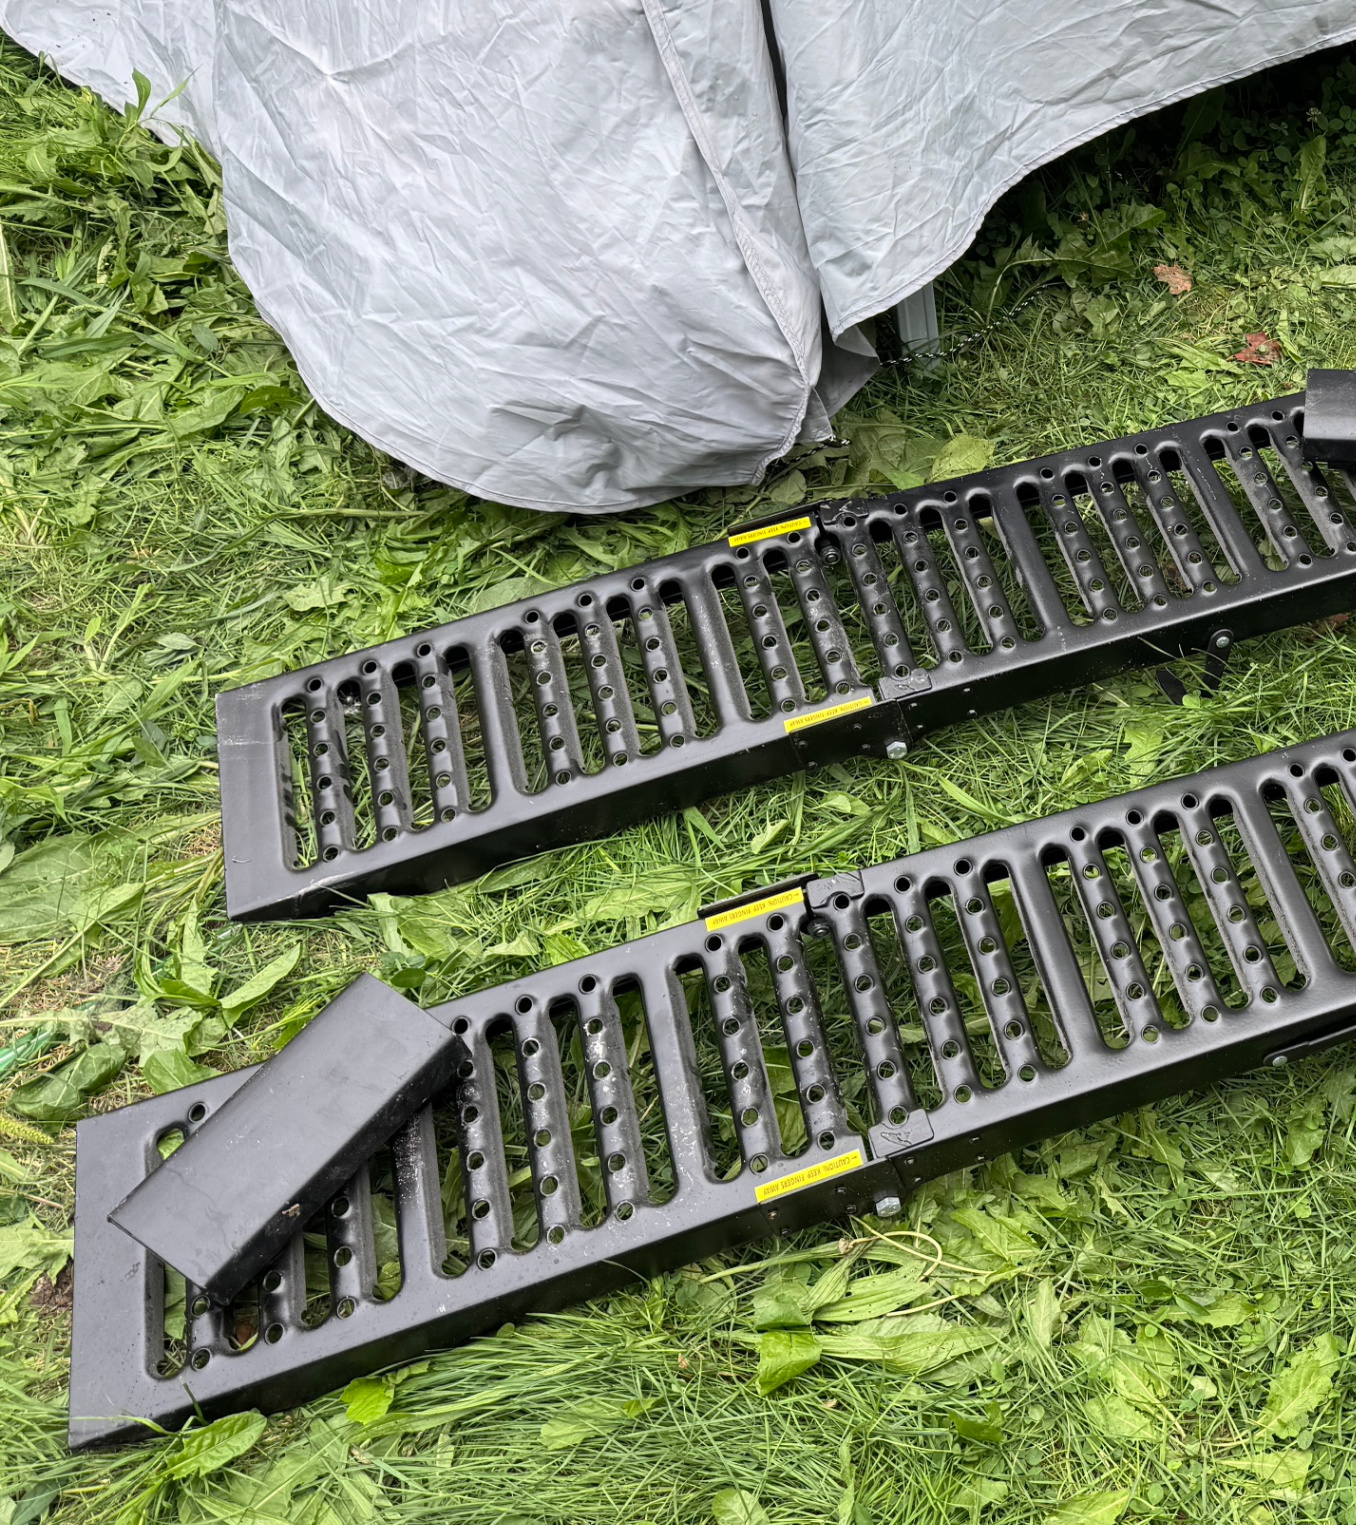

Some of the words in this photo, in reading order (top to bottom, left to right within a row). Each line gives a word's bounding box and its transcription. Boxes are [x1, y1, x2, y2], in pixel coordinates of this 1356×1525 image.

[728, 907, 750, 919] FINGERS
[752, 902, 765, 912] KEEP
[712, 915, 727, 925] AWAY
[806, 1167, 821, 1179] KEEP
[780, 1173, 804, 1188] FINGERS
[762, 1183, 779, 1195] AWAY
